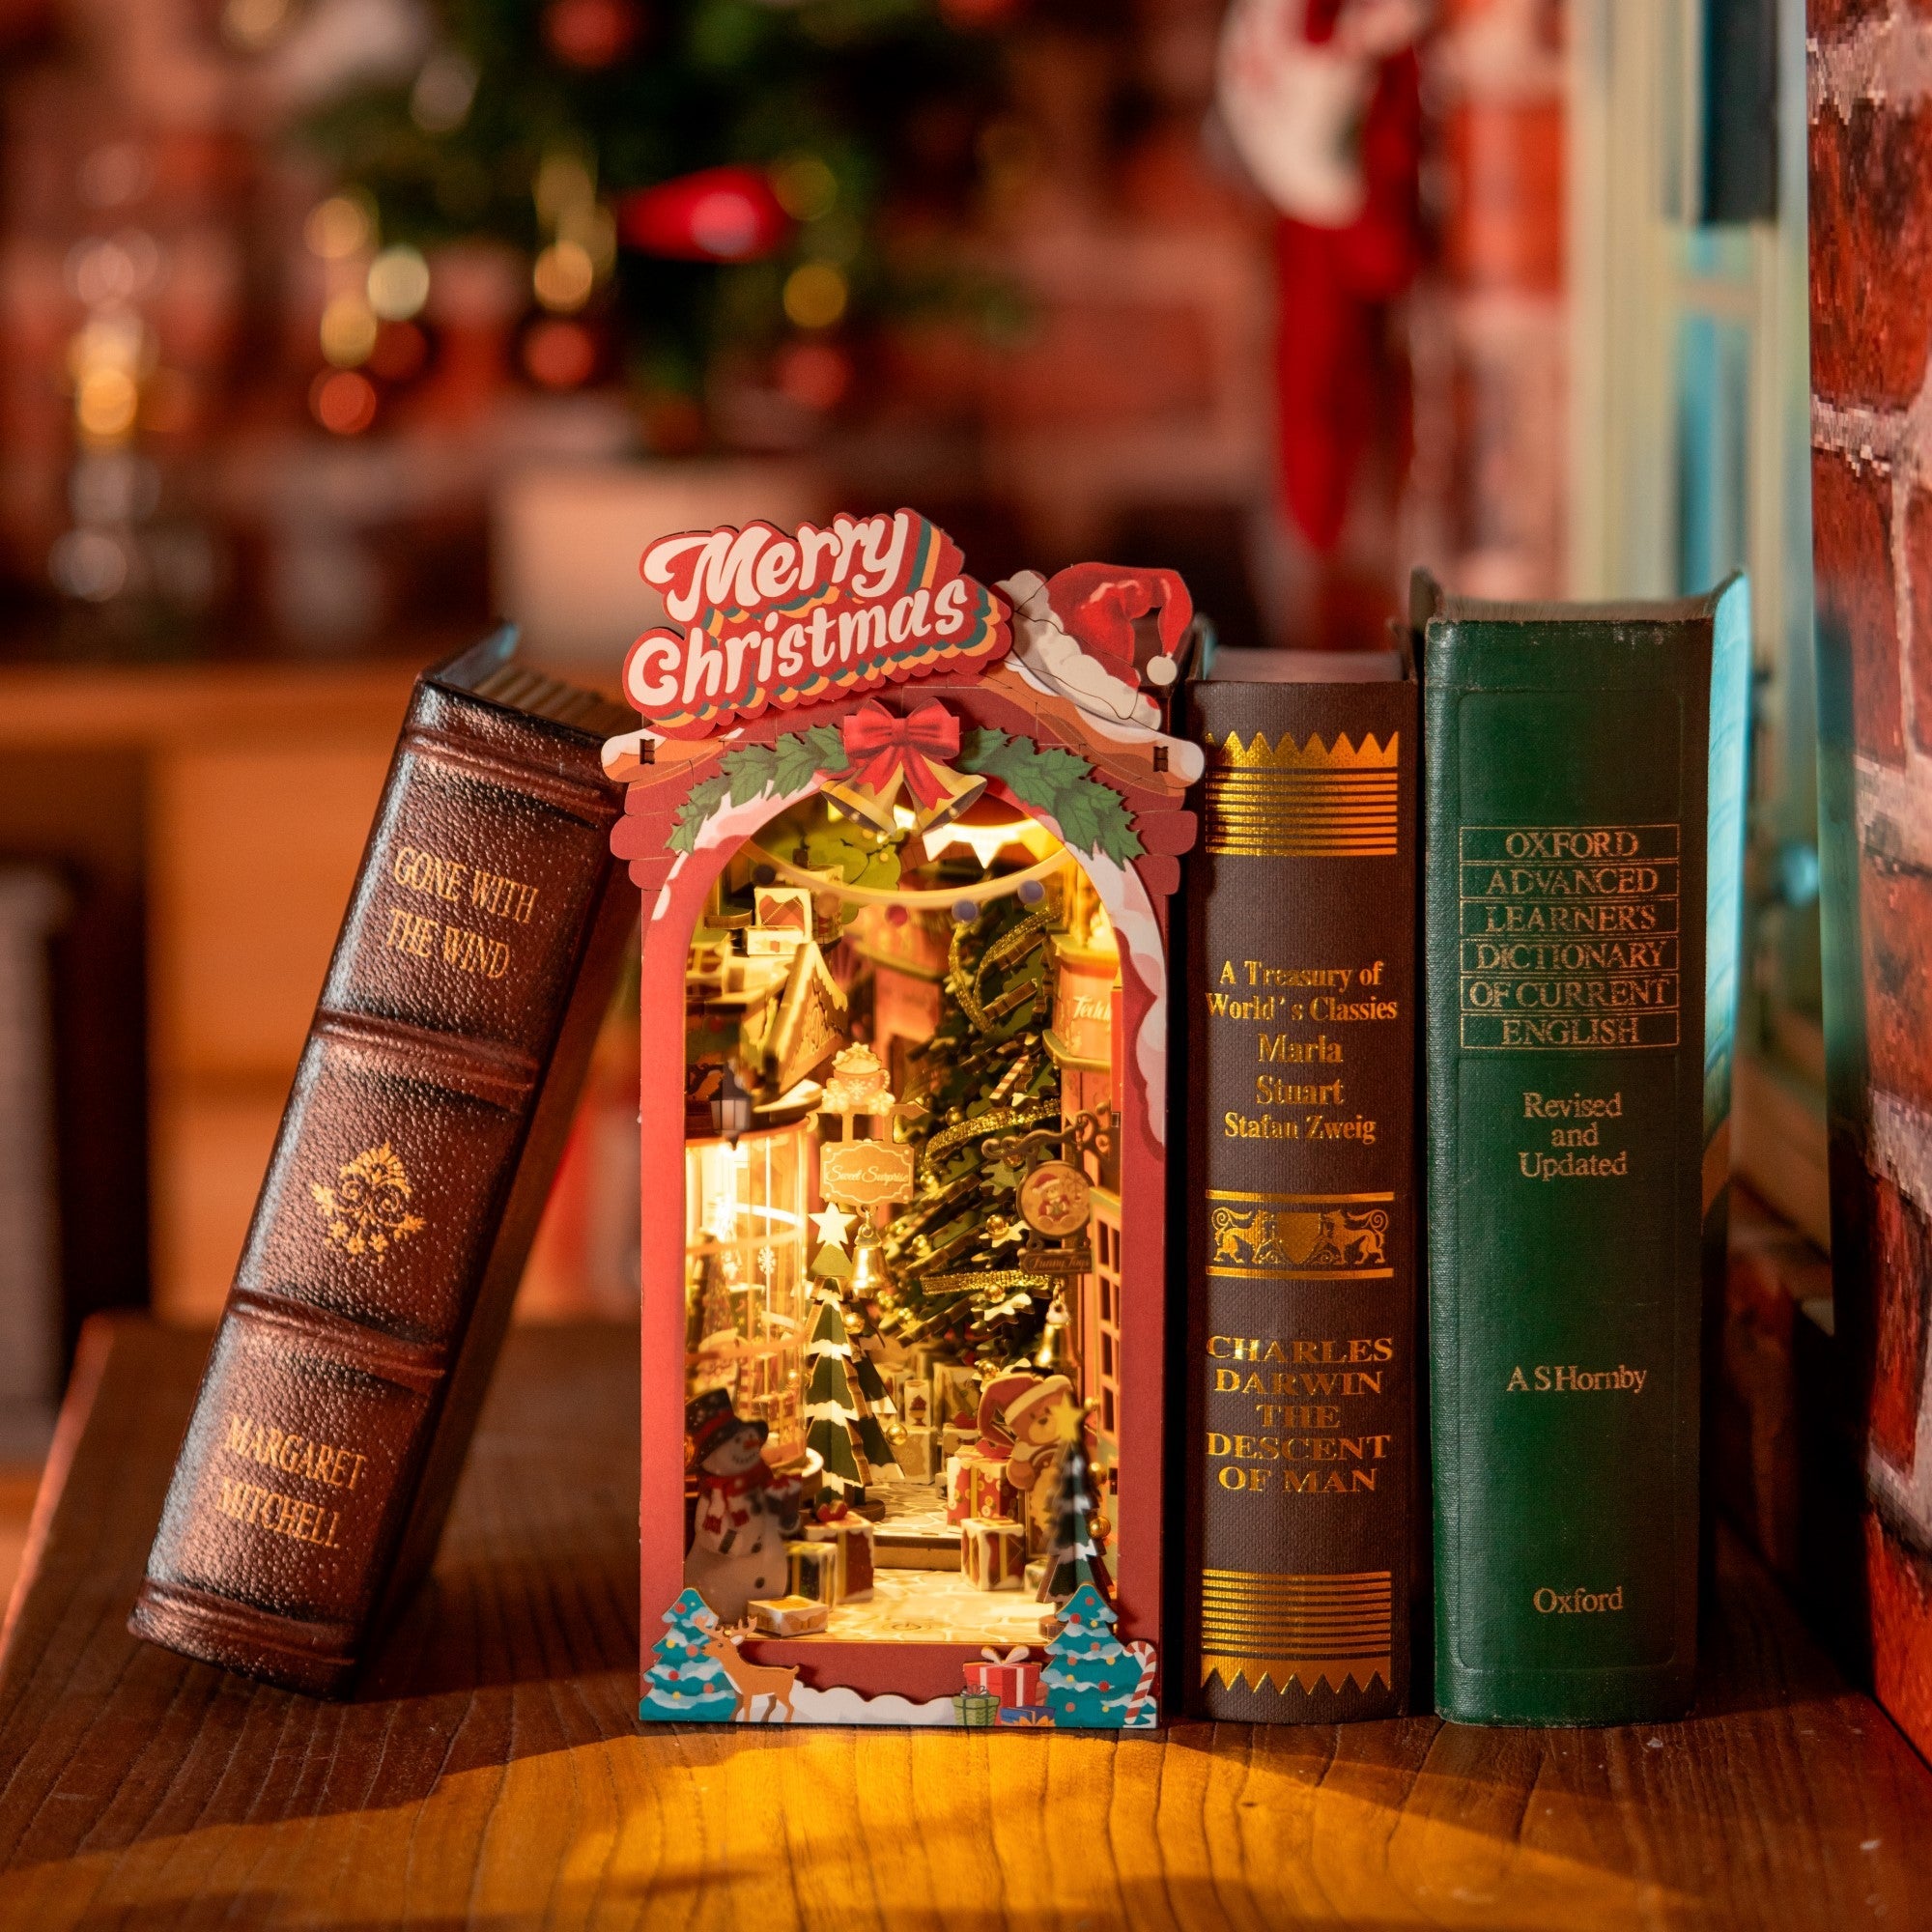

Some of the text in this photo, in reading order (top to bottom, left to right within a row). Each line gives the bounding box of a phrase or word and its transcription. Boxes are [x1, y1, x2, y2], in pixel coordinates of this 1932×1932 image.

[643, 513, 909, 622] Merry
[628, 579, 968, 706] Christmas
[1505, 831, 1639, 858] OXFORD
[394, 846, 539, 924] GONE WITH
[1486, 867, 1659, 895] ADVANCED
[386, 908, 510, 980] THE WIND
[1475, 941, 1667, 970] DICTIONARY
[1219, 960, 1384, 993] A Treasury of
[1468, 978, 1670, 1008] OF CURRENT
[1501, 1017, 1639, 1044] ENGLISH
[1256, 1074, 1346, 1105] Stuart
[1522, 1092, 1623, 1118] Revised
[1306, 1114, 1377, 1146] Zweig
[1550, 1122, 1599, 1147] and
[826, 1165, 909, 1186] Sweet Surprise
[1519, 1151, 1628, 1181] Updated
[1207, 1335, 1394, 1364] CHARLES
[1213, 1368, 1383, 1396] DARWIN
[1256, 1404, 1341, 1429] THE
[223, 1413, 369, 1491] MARGARET
[1206, 1432, 1392, 1461] DESCENT
[1218, 1465, 1378, 1493] OF MAN
[1533, 1585, 1624, 1613] Oxford
